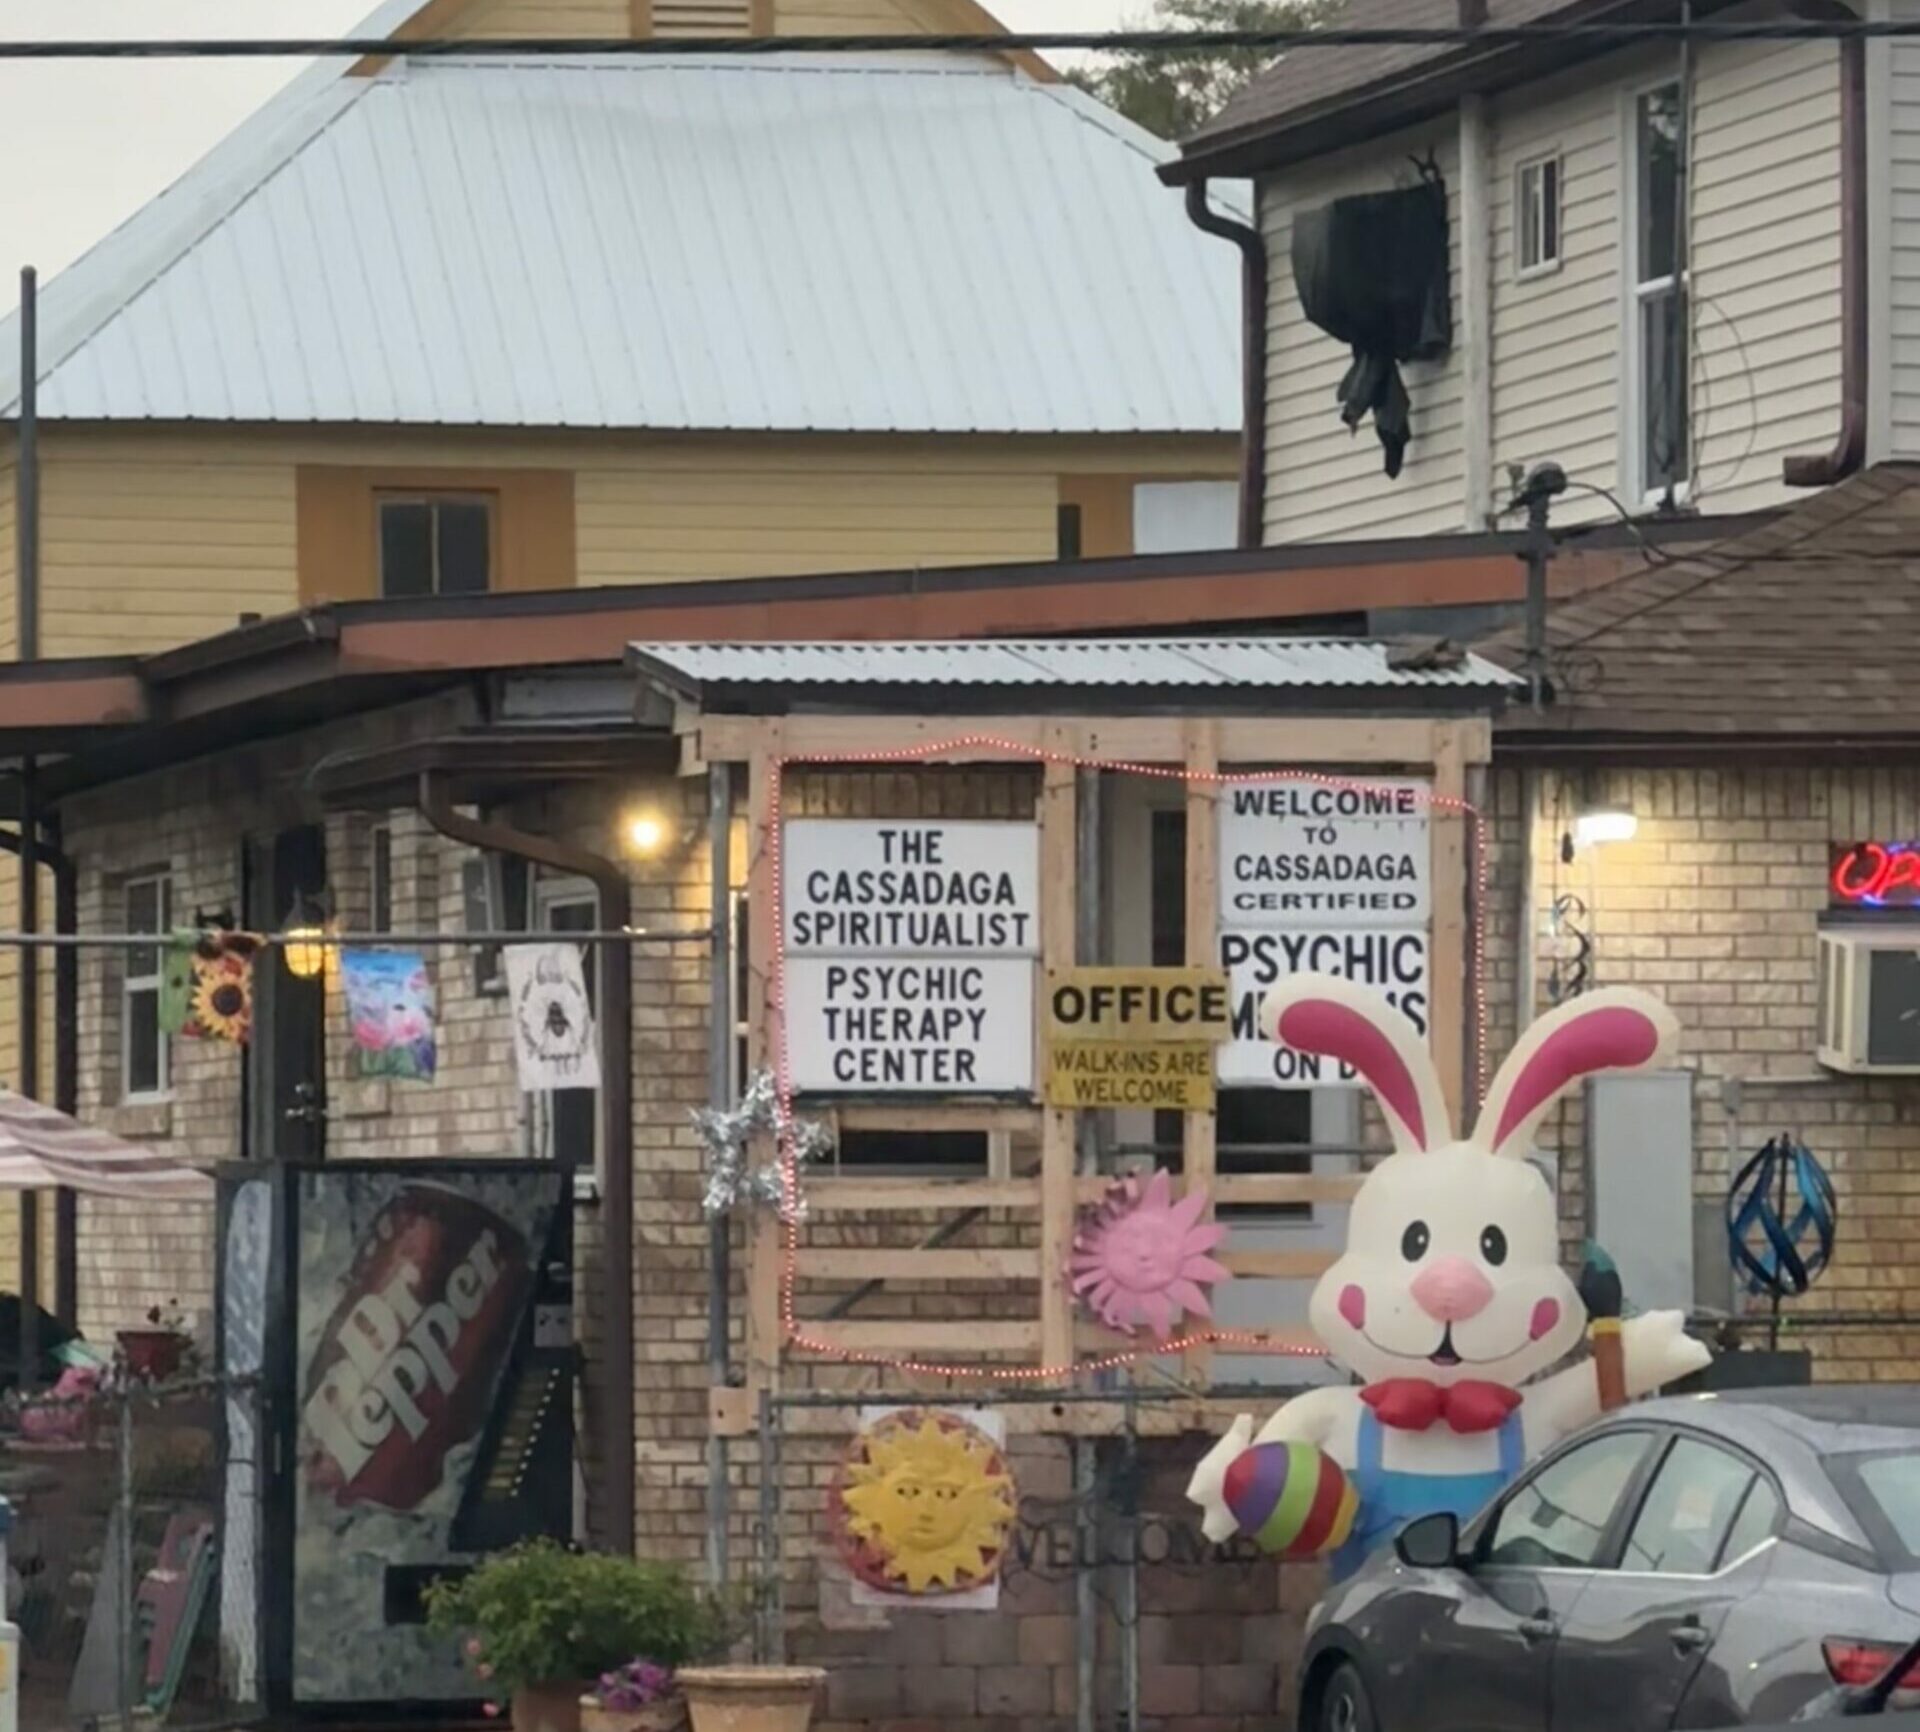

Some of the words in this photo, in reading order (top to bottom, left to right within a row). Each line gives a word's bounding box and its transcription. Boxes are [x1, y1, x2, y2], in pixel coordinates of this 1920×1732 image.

[1233, 788, 1416, 816] WELCOME
[878, 830, 943, 864] THE
[1303, 825, 1338, 845] TO
[1234, 854, 1417, 881] CASSADAGA
[807, 870, 1015, 905] CASSADAGA
[1233, 892, 1417, 910] CERTIFIED
[793, 911, 1030, 946] SPIRITUALIST
[1221, 934, 1424, 984] PSYCHIC
[827, 966, 983, 1001] PSYCHIC
[1052, 985, 1226, 1024] OFFICE
[823, 1007, 986, 1042] THERAPY
[833, 1048, 976, 1083] CENTER
[1165, 1052, 1210, 1076] ARE
[1274, 1047, 1321, 1081] ON
[1073, 1078, 1189, 1104] WELCOME
[336, 1262, 423, 1382] Dr
[302, 1228, 498, 1484] Pepper
